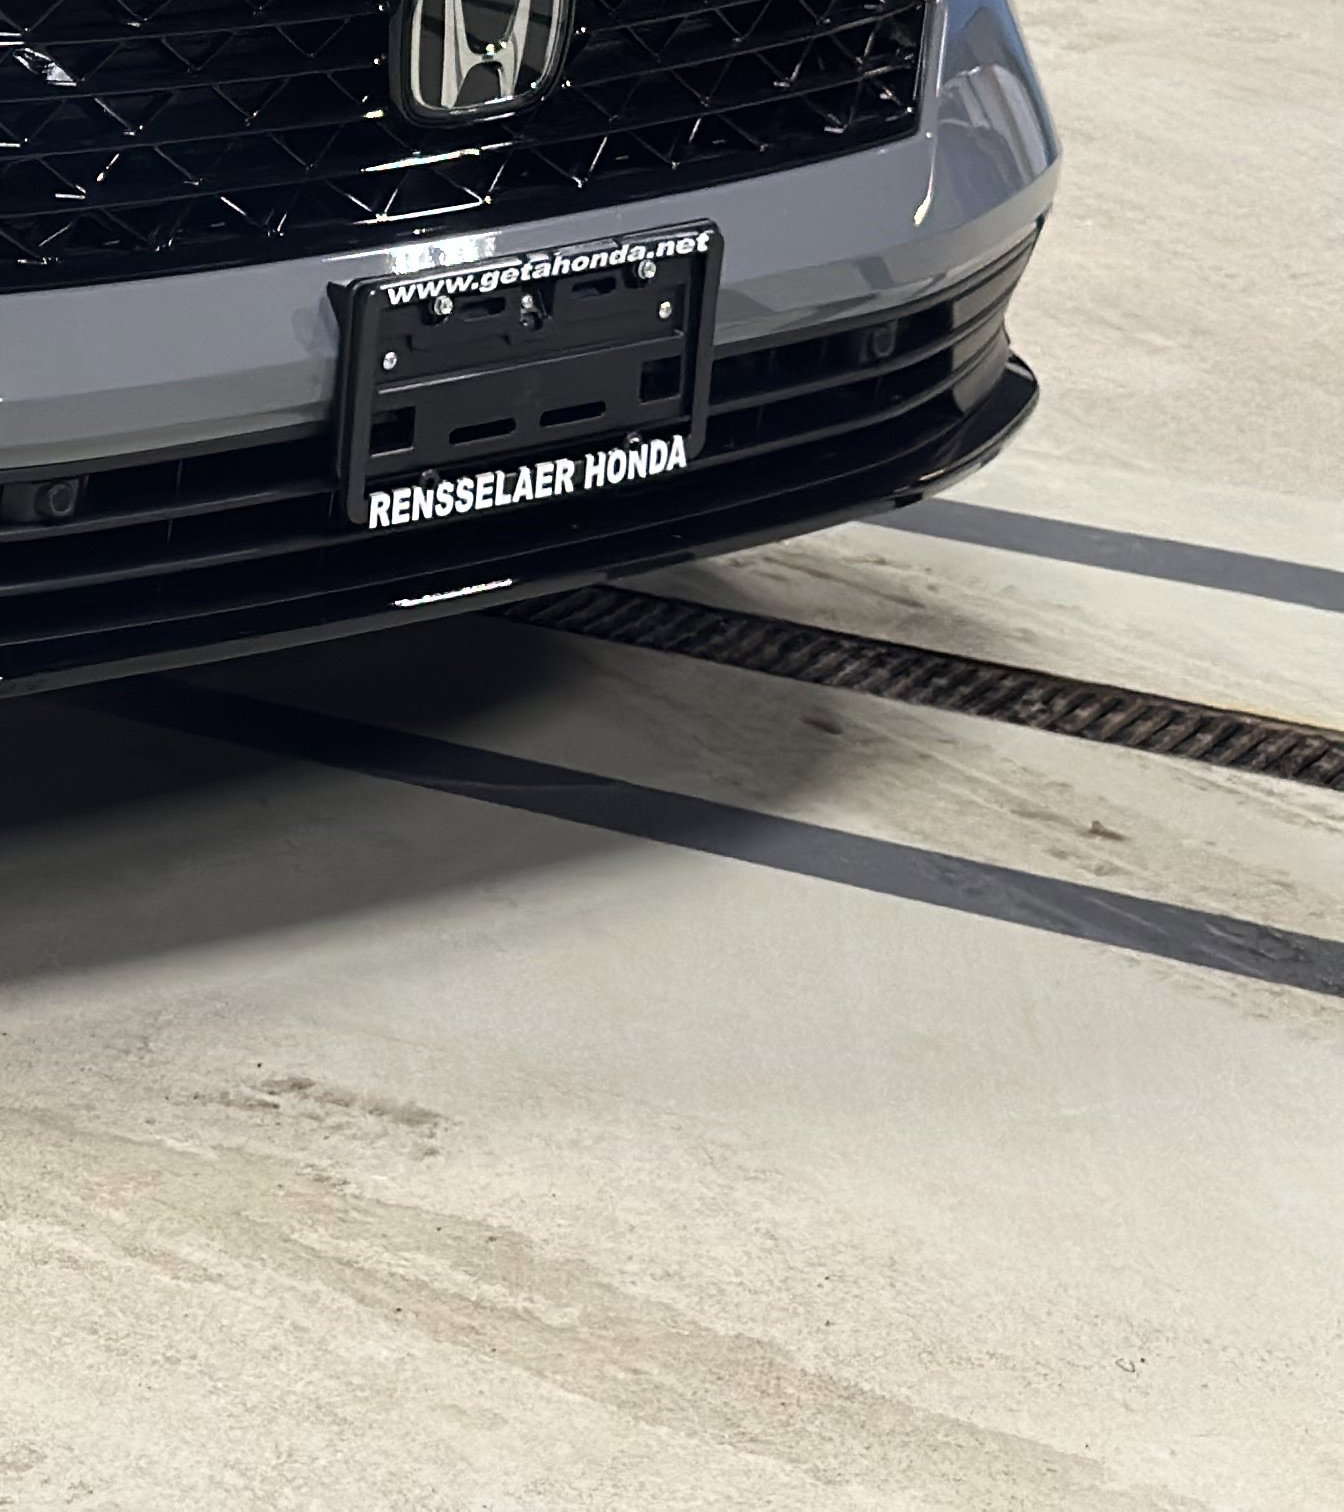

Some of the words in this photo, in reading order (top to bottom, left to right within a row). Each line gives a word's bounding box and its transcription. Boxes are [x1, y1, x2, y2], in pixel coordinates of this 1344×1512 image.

[387, 232, 711, 306] www.getahonda.net
[367, 457, 575, 530] RENSSELAER
[583, 434, 688, 490] HONDA
